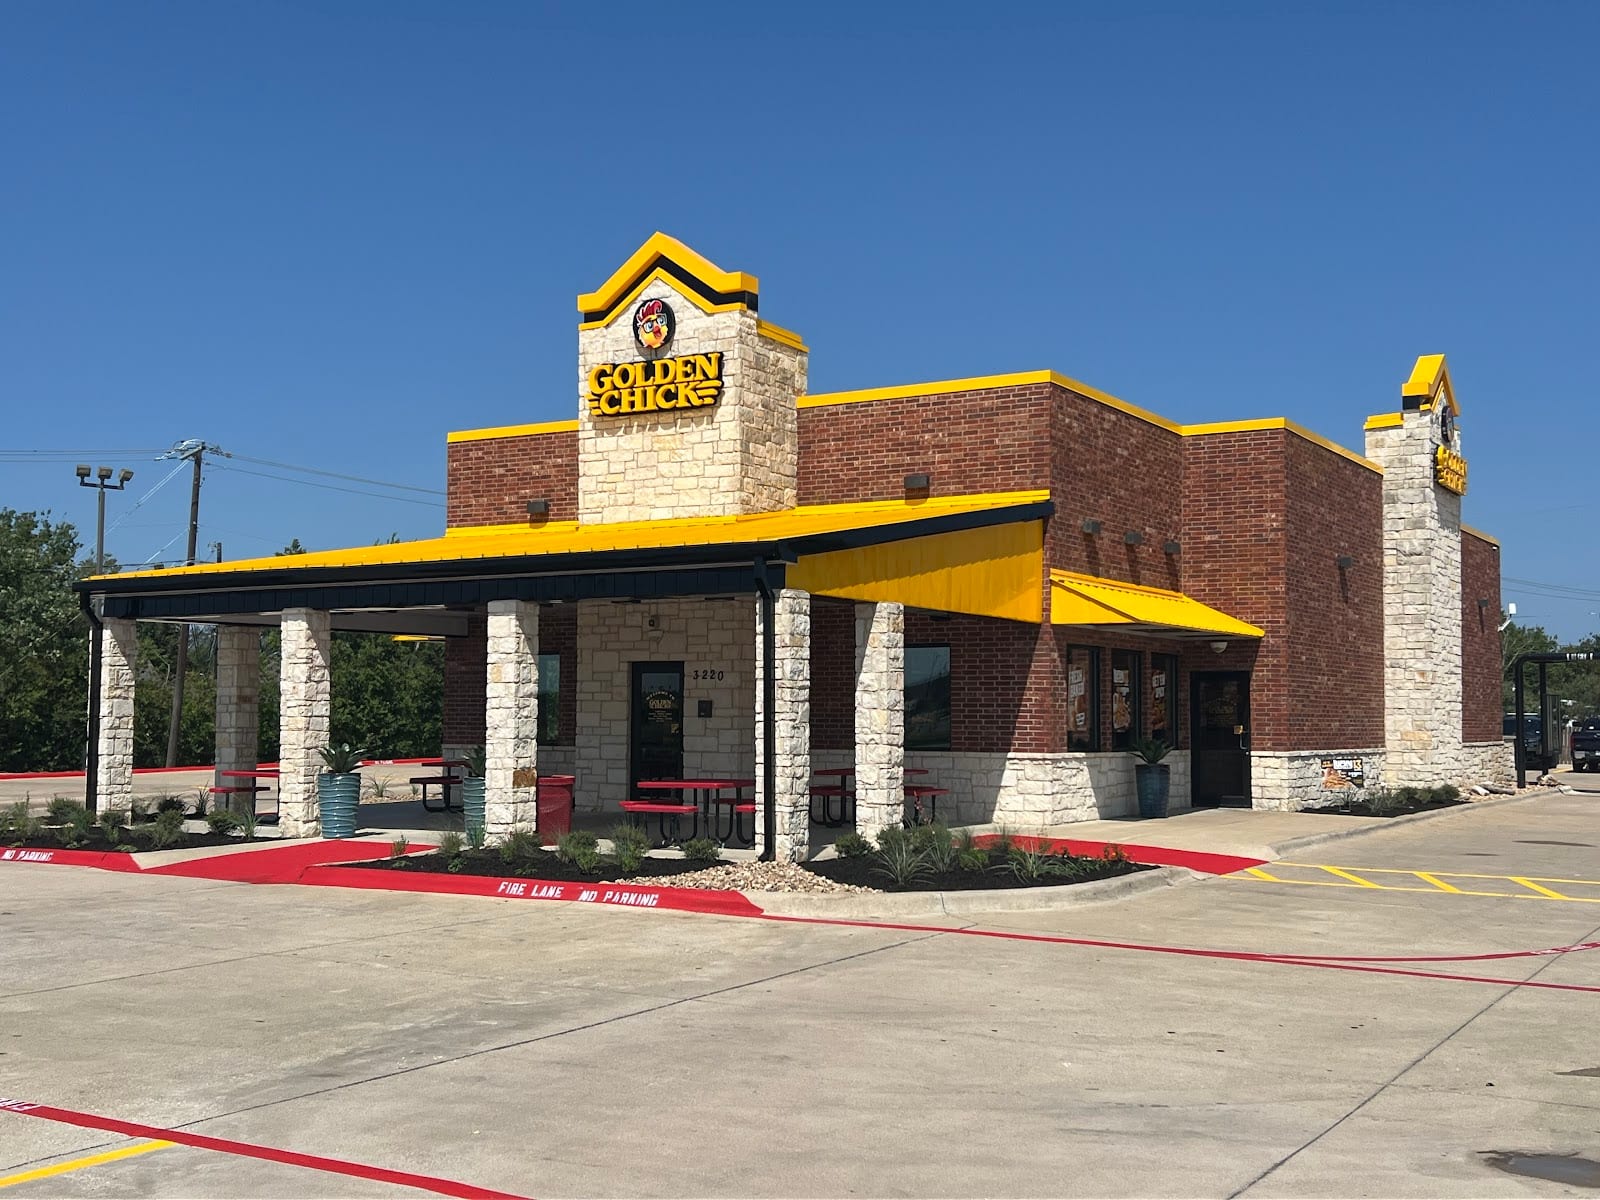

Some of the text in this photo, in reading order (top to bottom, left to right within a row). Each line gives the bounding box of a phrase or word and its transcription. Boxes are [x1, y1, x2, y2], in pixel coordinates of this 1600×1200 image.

[588, 352, 721, 394] GOLDEN
[599, 381, 706, 416] CHICK
[693, 669, 724, 681] 3220
[1, 849, 54, 861] NO PARKING
[498, 881, 659, 907] FIRE LANE NO PARKING
